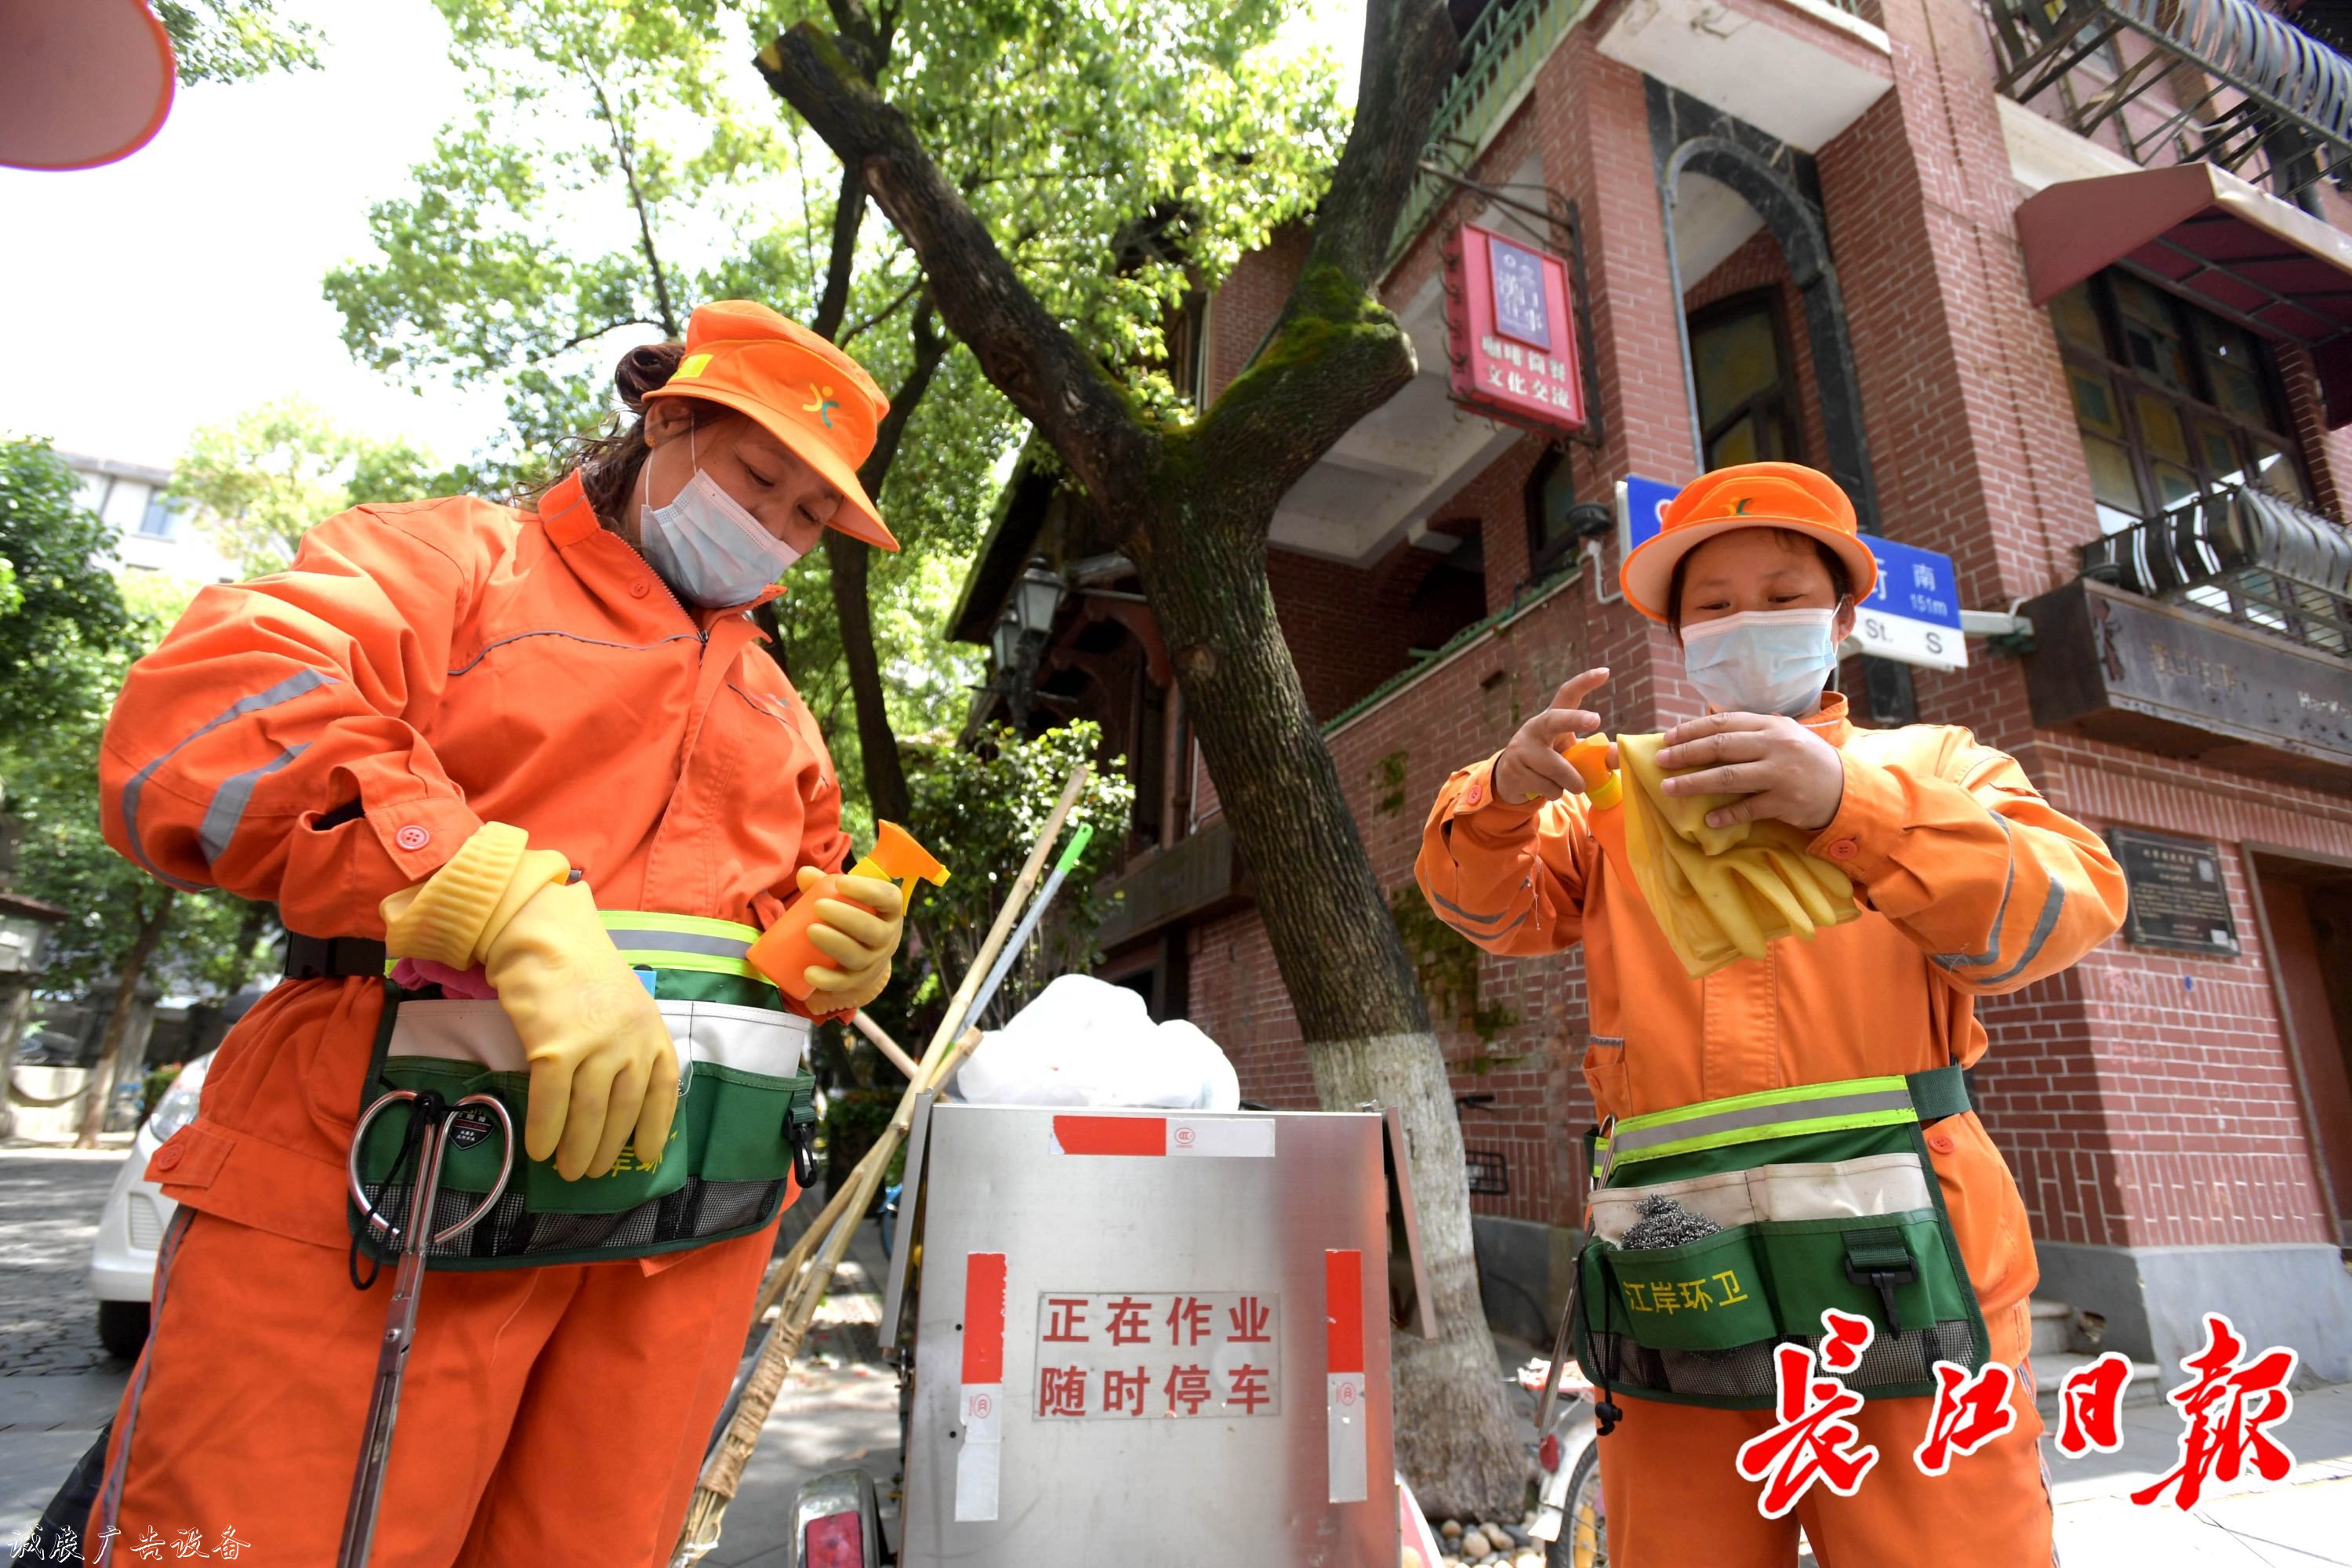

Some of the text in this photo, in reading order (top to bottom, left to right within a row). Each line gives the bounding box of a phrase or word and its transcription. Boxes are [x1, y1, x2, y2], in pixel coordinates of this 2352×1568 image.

[1486, 365, 1570, 409] 文化交流
[1912, 563, 1936, 592] 南
[1910, 593, 1948, 617] 151m
[1865, 618, 1944, 655] St. S
[1623, 1269, 1749, 1316] 江岸环卫
[1042, 1296, 1272, 1347] 正在作业
[1039, 1363, 1271, 1417] 随时停车
